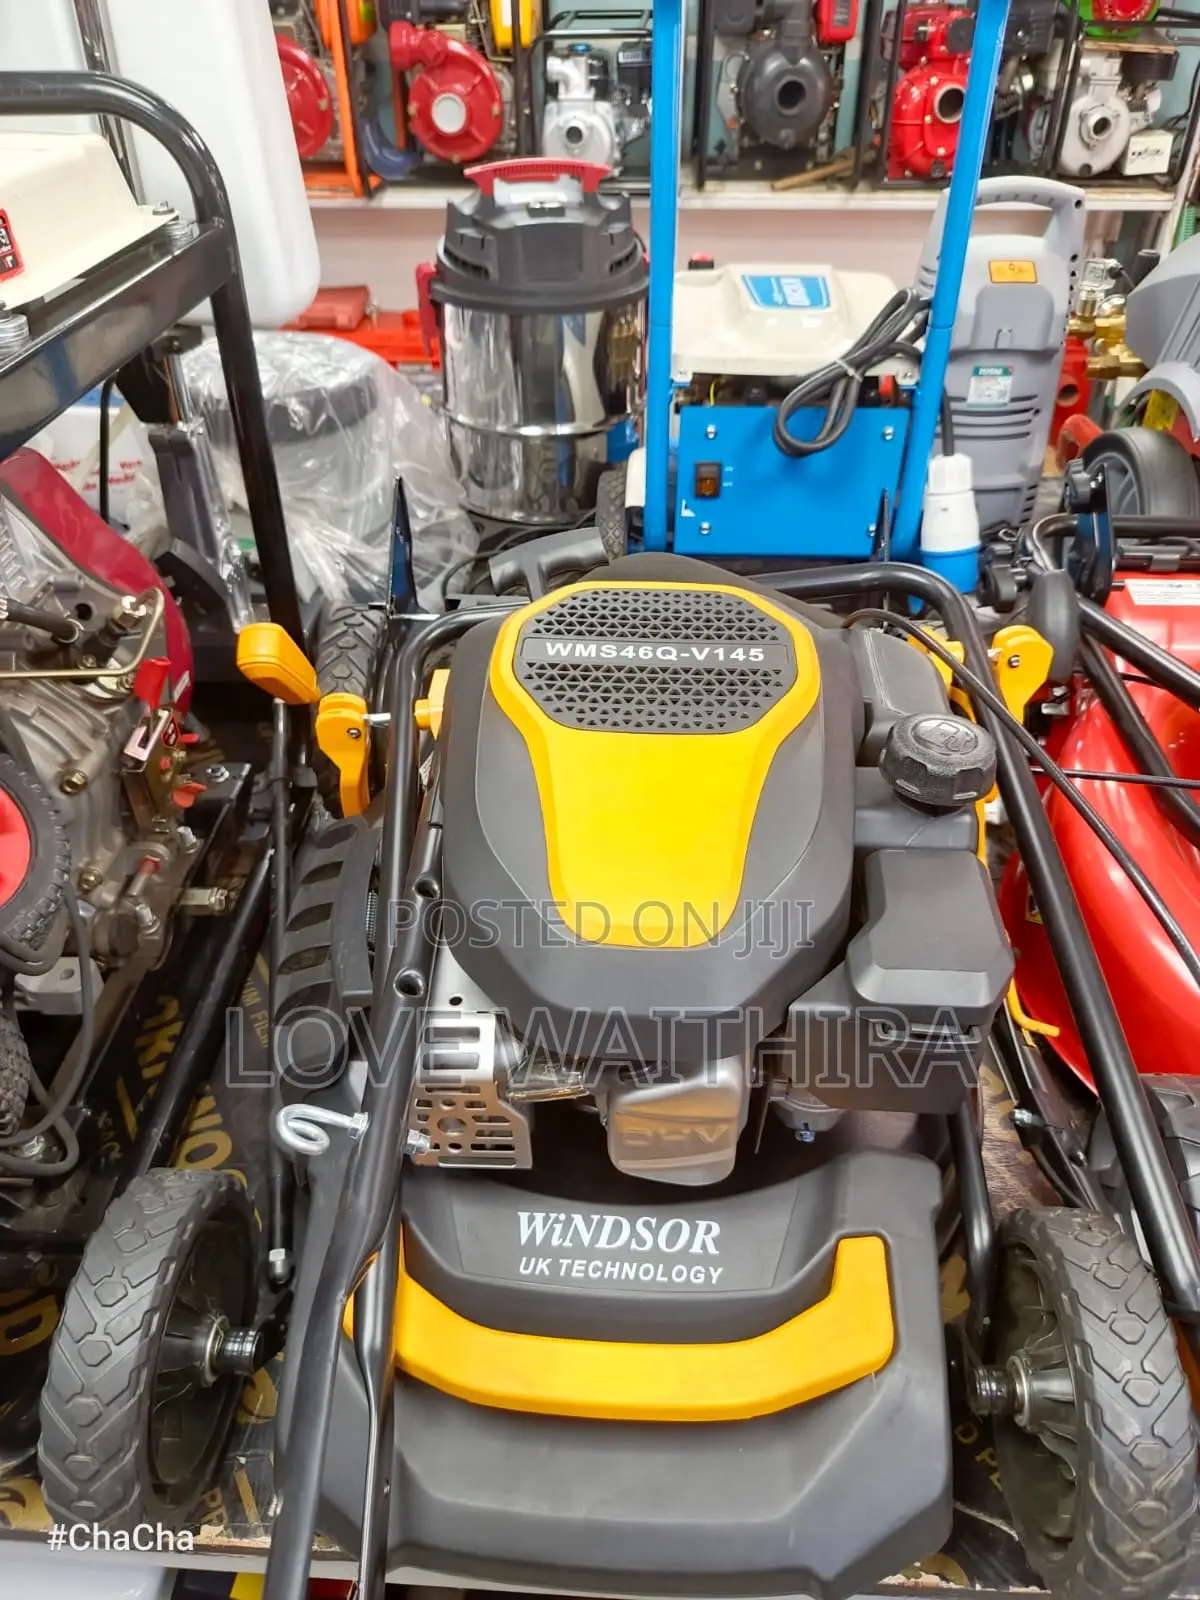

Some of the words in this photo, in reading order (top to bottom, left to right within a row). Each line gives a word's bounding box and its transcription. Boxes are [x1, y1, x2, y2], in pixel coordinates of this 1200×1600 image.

[545, 642, 765, 662] WMS46Q-V145
[519, 1256, 552, 1276] UK
[559, 1258, 724, 1285] TECHNOLOGY
